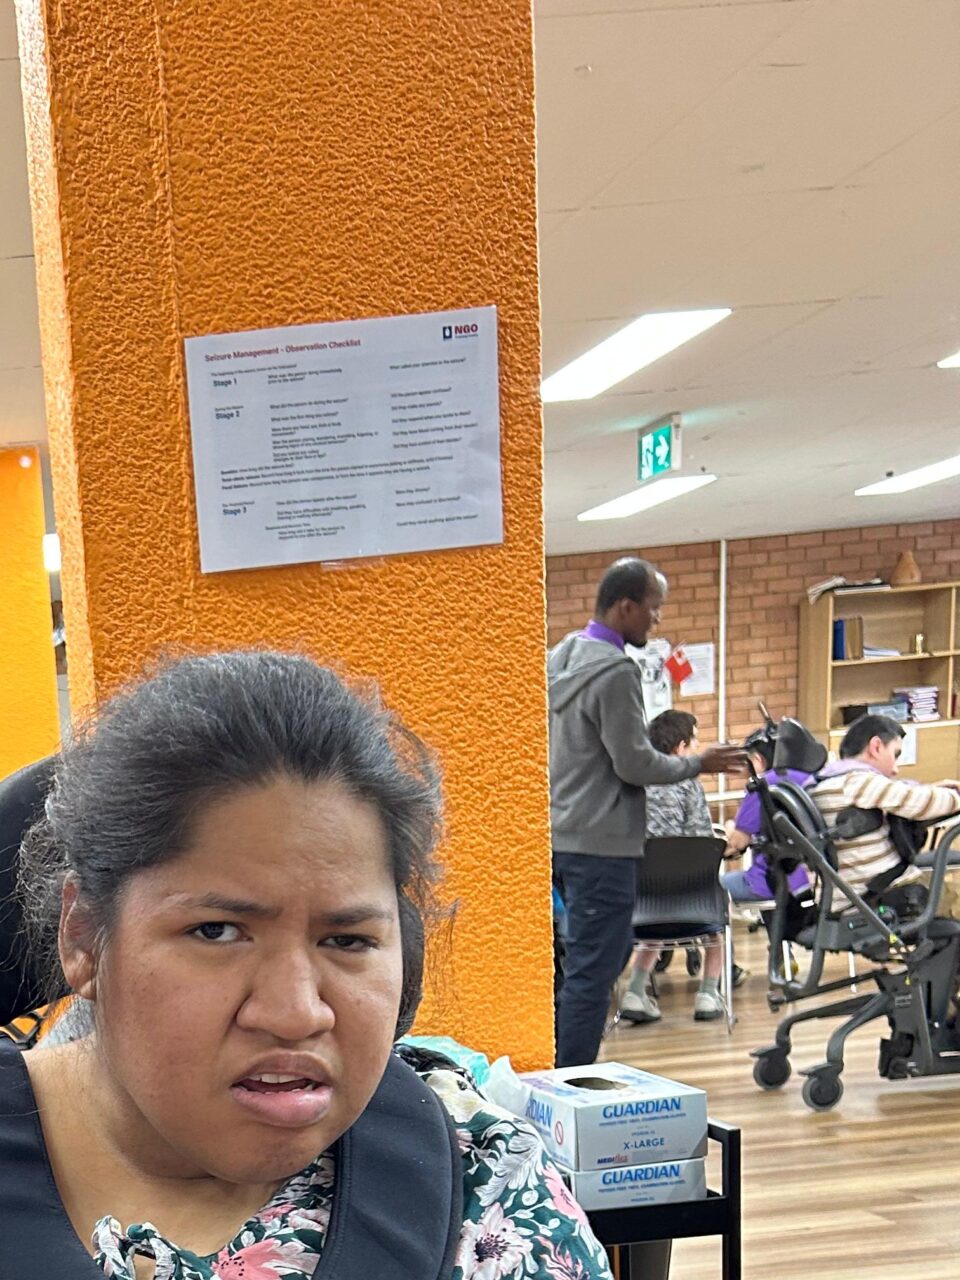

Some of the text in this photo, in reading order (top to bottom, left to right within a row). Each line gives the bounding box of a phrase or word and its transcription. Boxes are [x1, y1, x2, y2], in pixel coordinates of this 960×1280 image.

[454, 324, 479, 334] NGO
[205, 351, 232, 362] Seizure
[233, 347, 279, 359] Management
[285, 342, 328, 353] Observation
[328, 339, 362, 349] Checklist
[213, 377, 238, 388] Stage 1
[215, 412, 235, 420] Stage
[223, 508, 241, 516] Stage
[602, 1097, 681, 1119] GUARDIAN
[623, 1137, 665, 1151] X-LARGE
[602, 1164, 680, 1185] GUARDIAN
